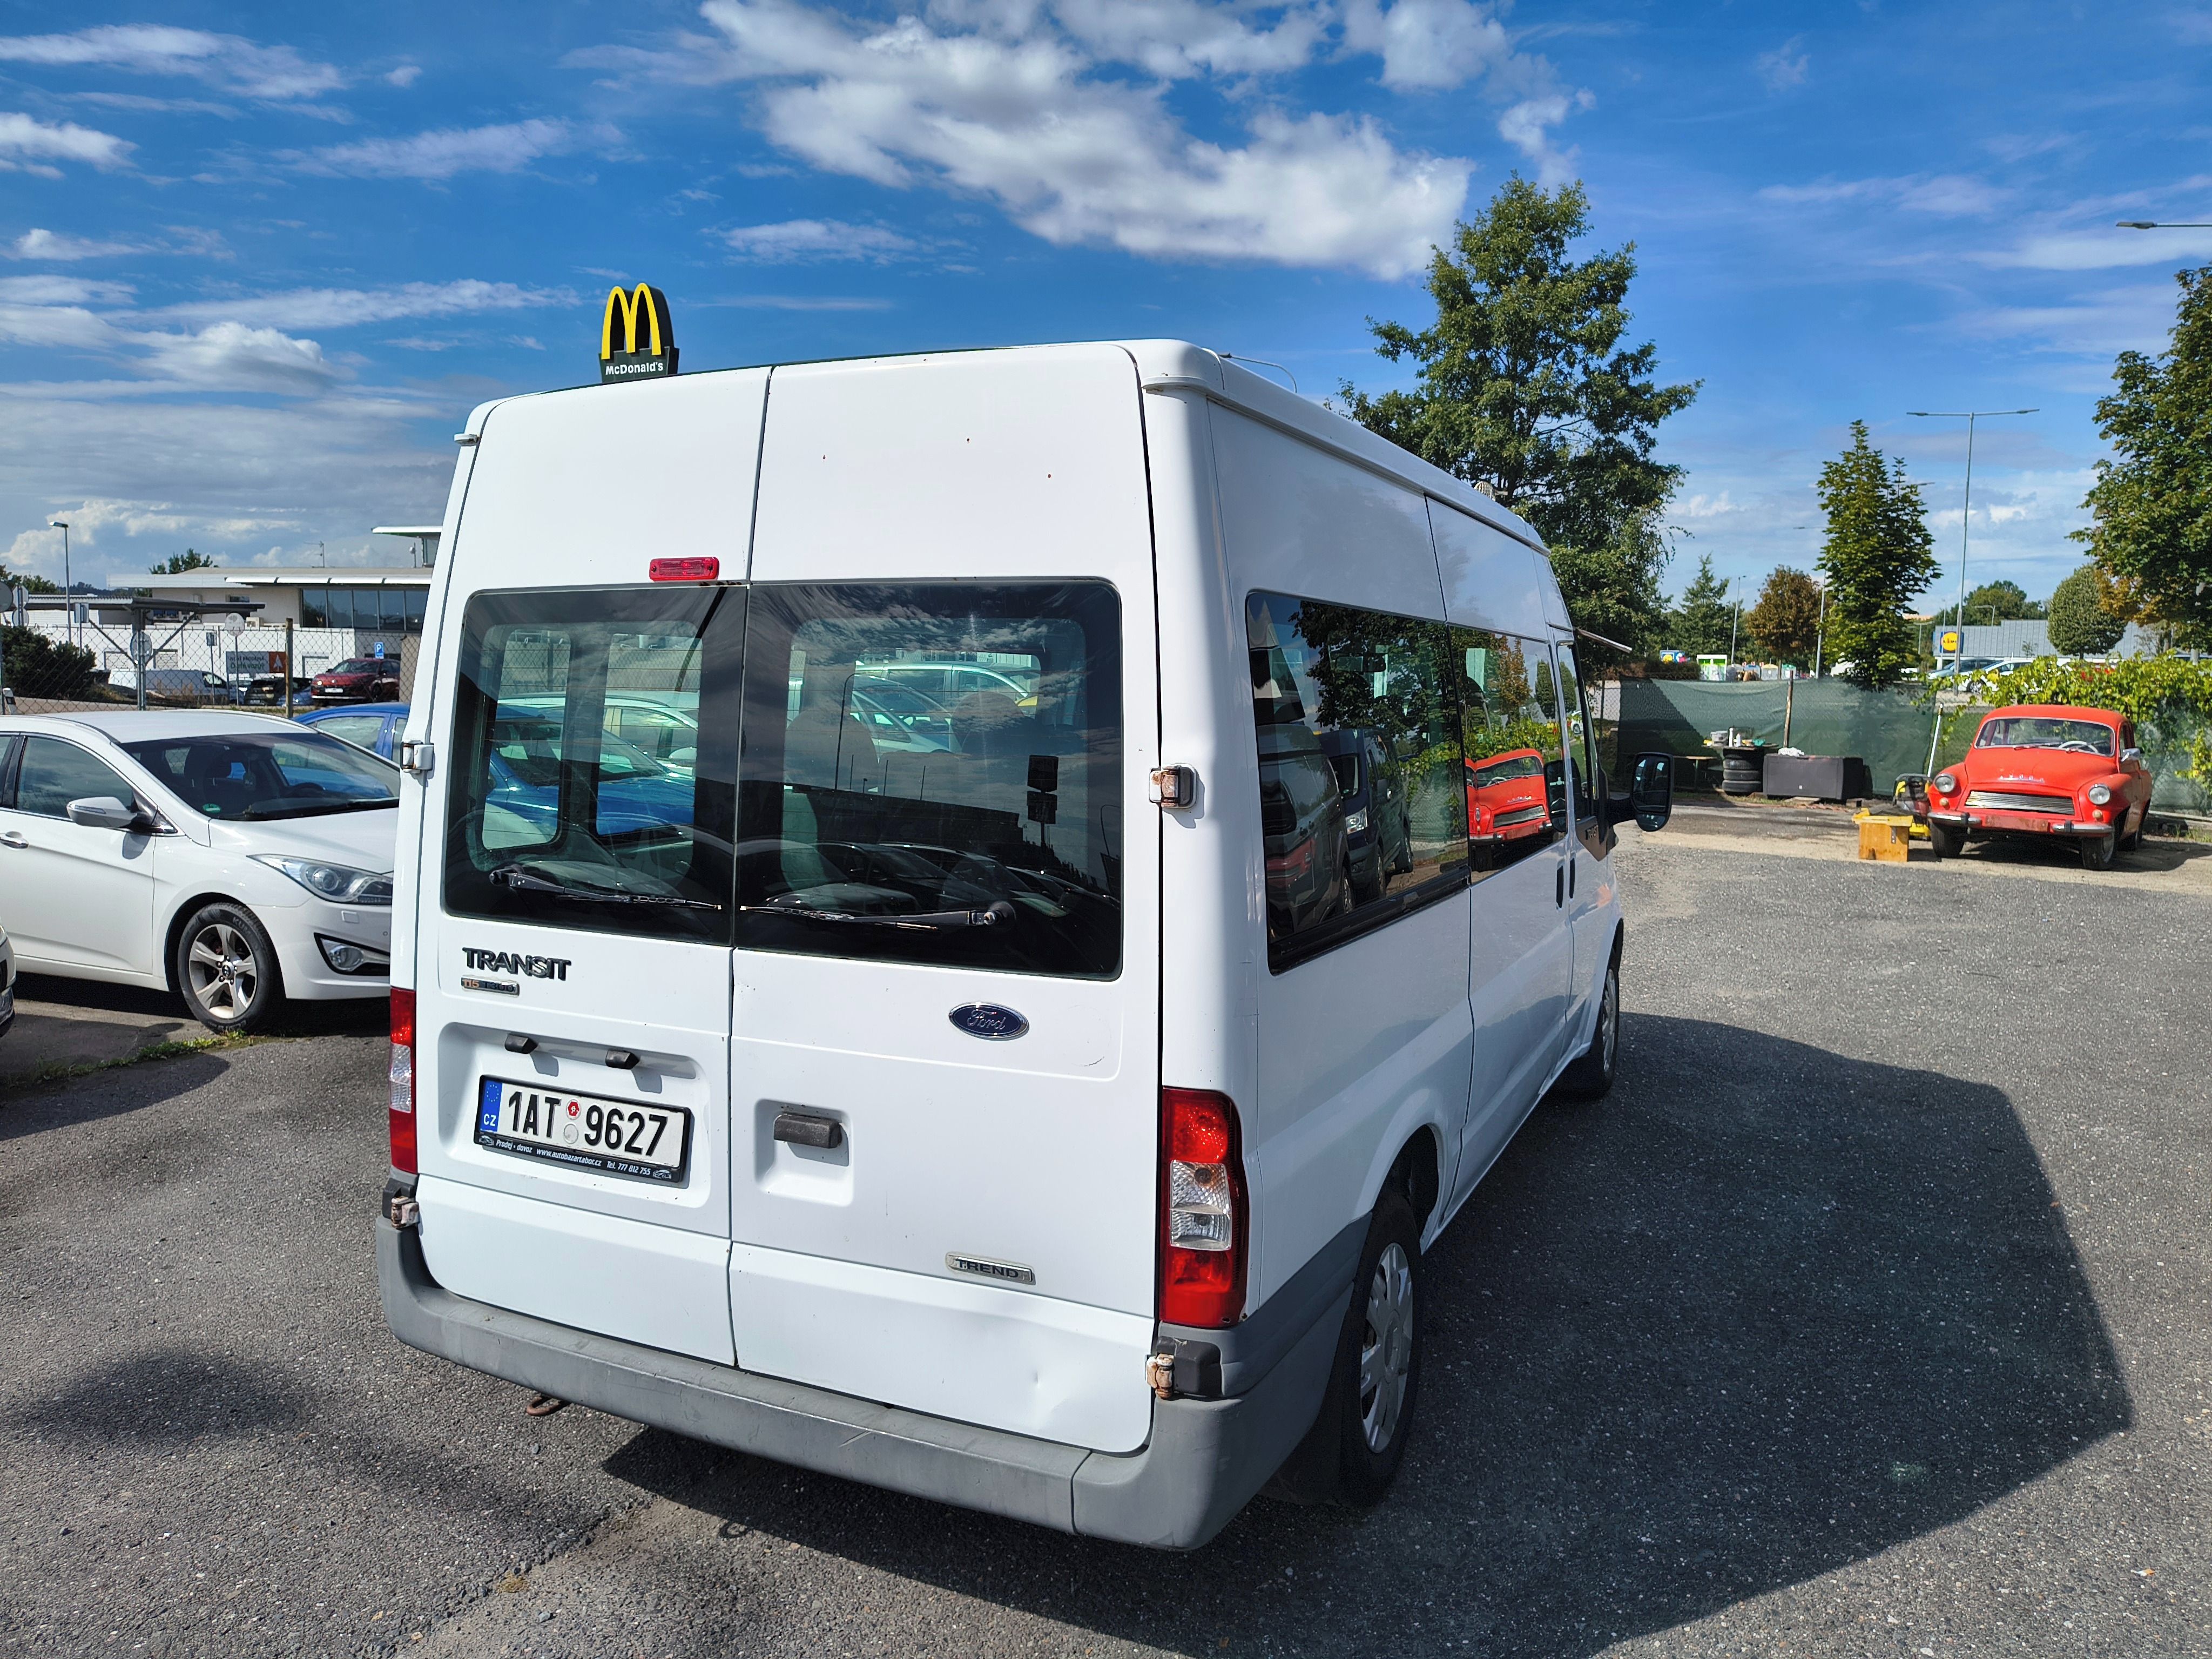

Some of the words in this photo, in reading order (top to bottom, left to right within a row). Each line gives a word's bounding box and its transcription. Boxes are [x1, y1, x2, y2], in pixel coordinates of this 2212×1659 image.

[605, 361, 664, 375] McDonald's
[462, 947, 572, 981] TRANSIT
[967, 1009, 1006, 1030] Ford
[483, 1114, 496, 1127] CZ
[509, 1091, 562, 1137] 1AT
[584, 1104, 669, 1157] 9627
[496, 1139, 513, 1150] Prodej
[516, 1144, 533, 1153] dovoz
[536, 1148, 602, 1166] www.autobazartabor.cz
[606, 1161, 616, 1169] Tel.
[617, 1163, 629, 1171] 777
[955, 1258, 1019, 1278] TREND
